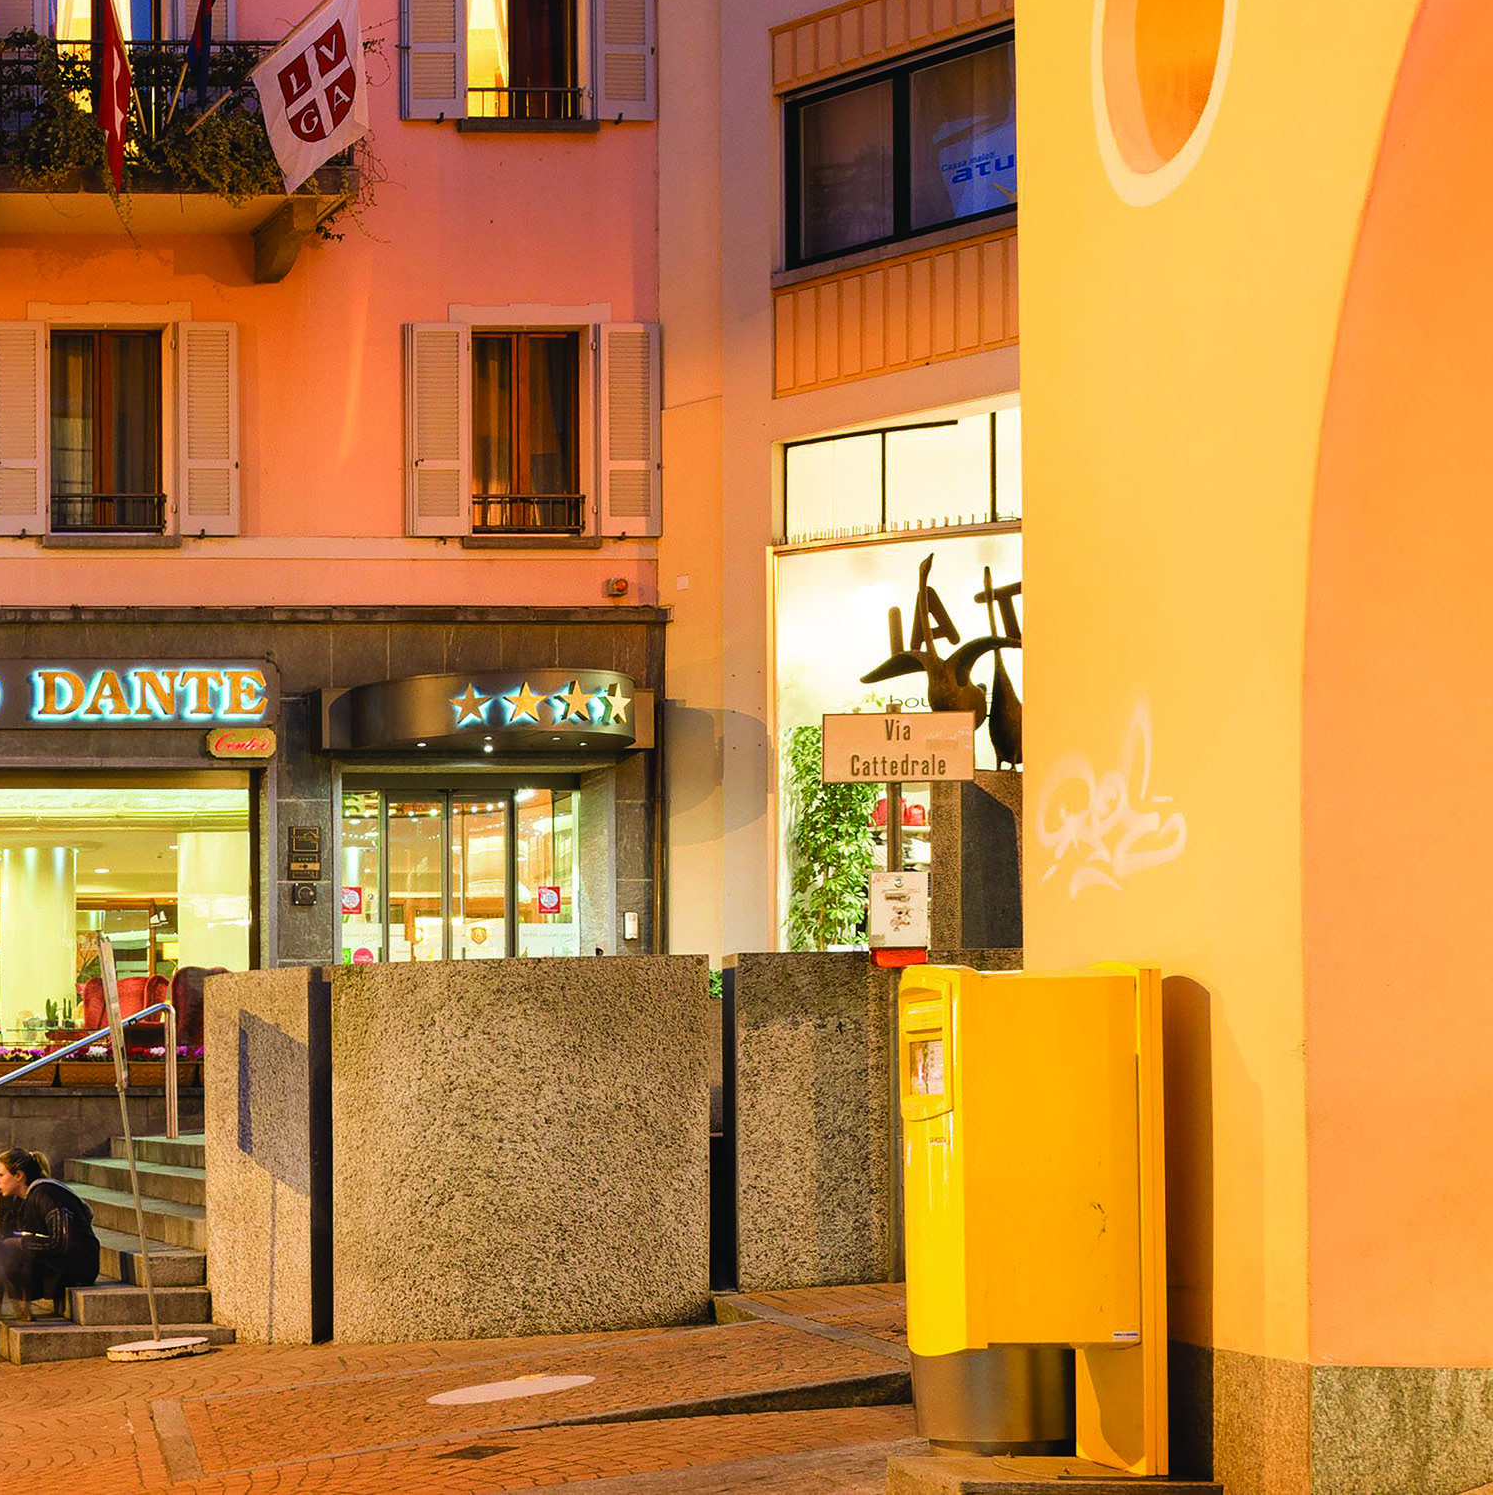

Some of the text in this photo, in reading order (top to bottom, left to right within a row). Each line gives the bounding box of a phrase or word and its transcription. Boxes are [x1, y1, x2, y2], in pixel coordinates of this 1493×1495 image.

[319, 33, 337, 63] V
[300, 84, 352, 135] G A
[37, 669, 268, 715] DANTE
[884, 718, 911, 741] Via
[851, 753, 946, 777] Cattedrale
